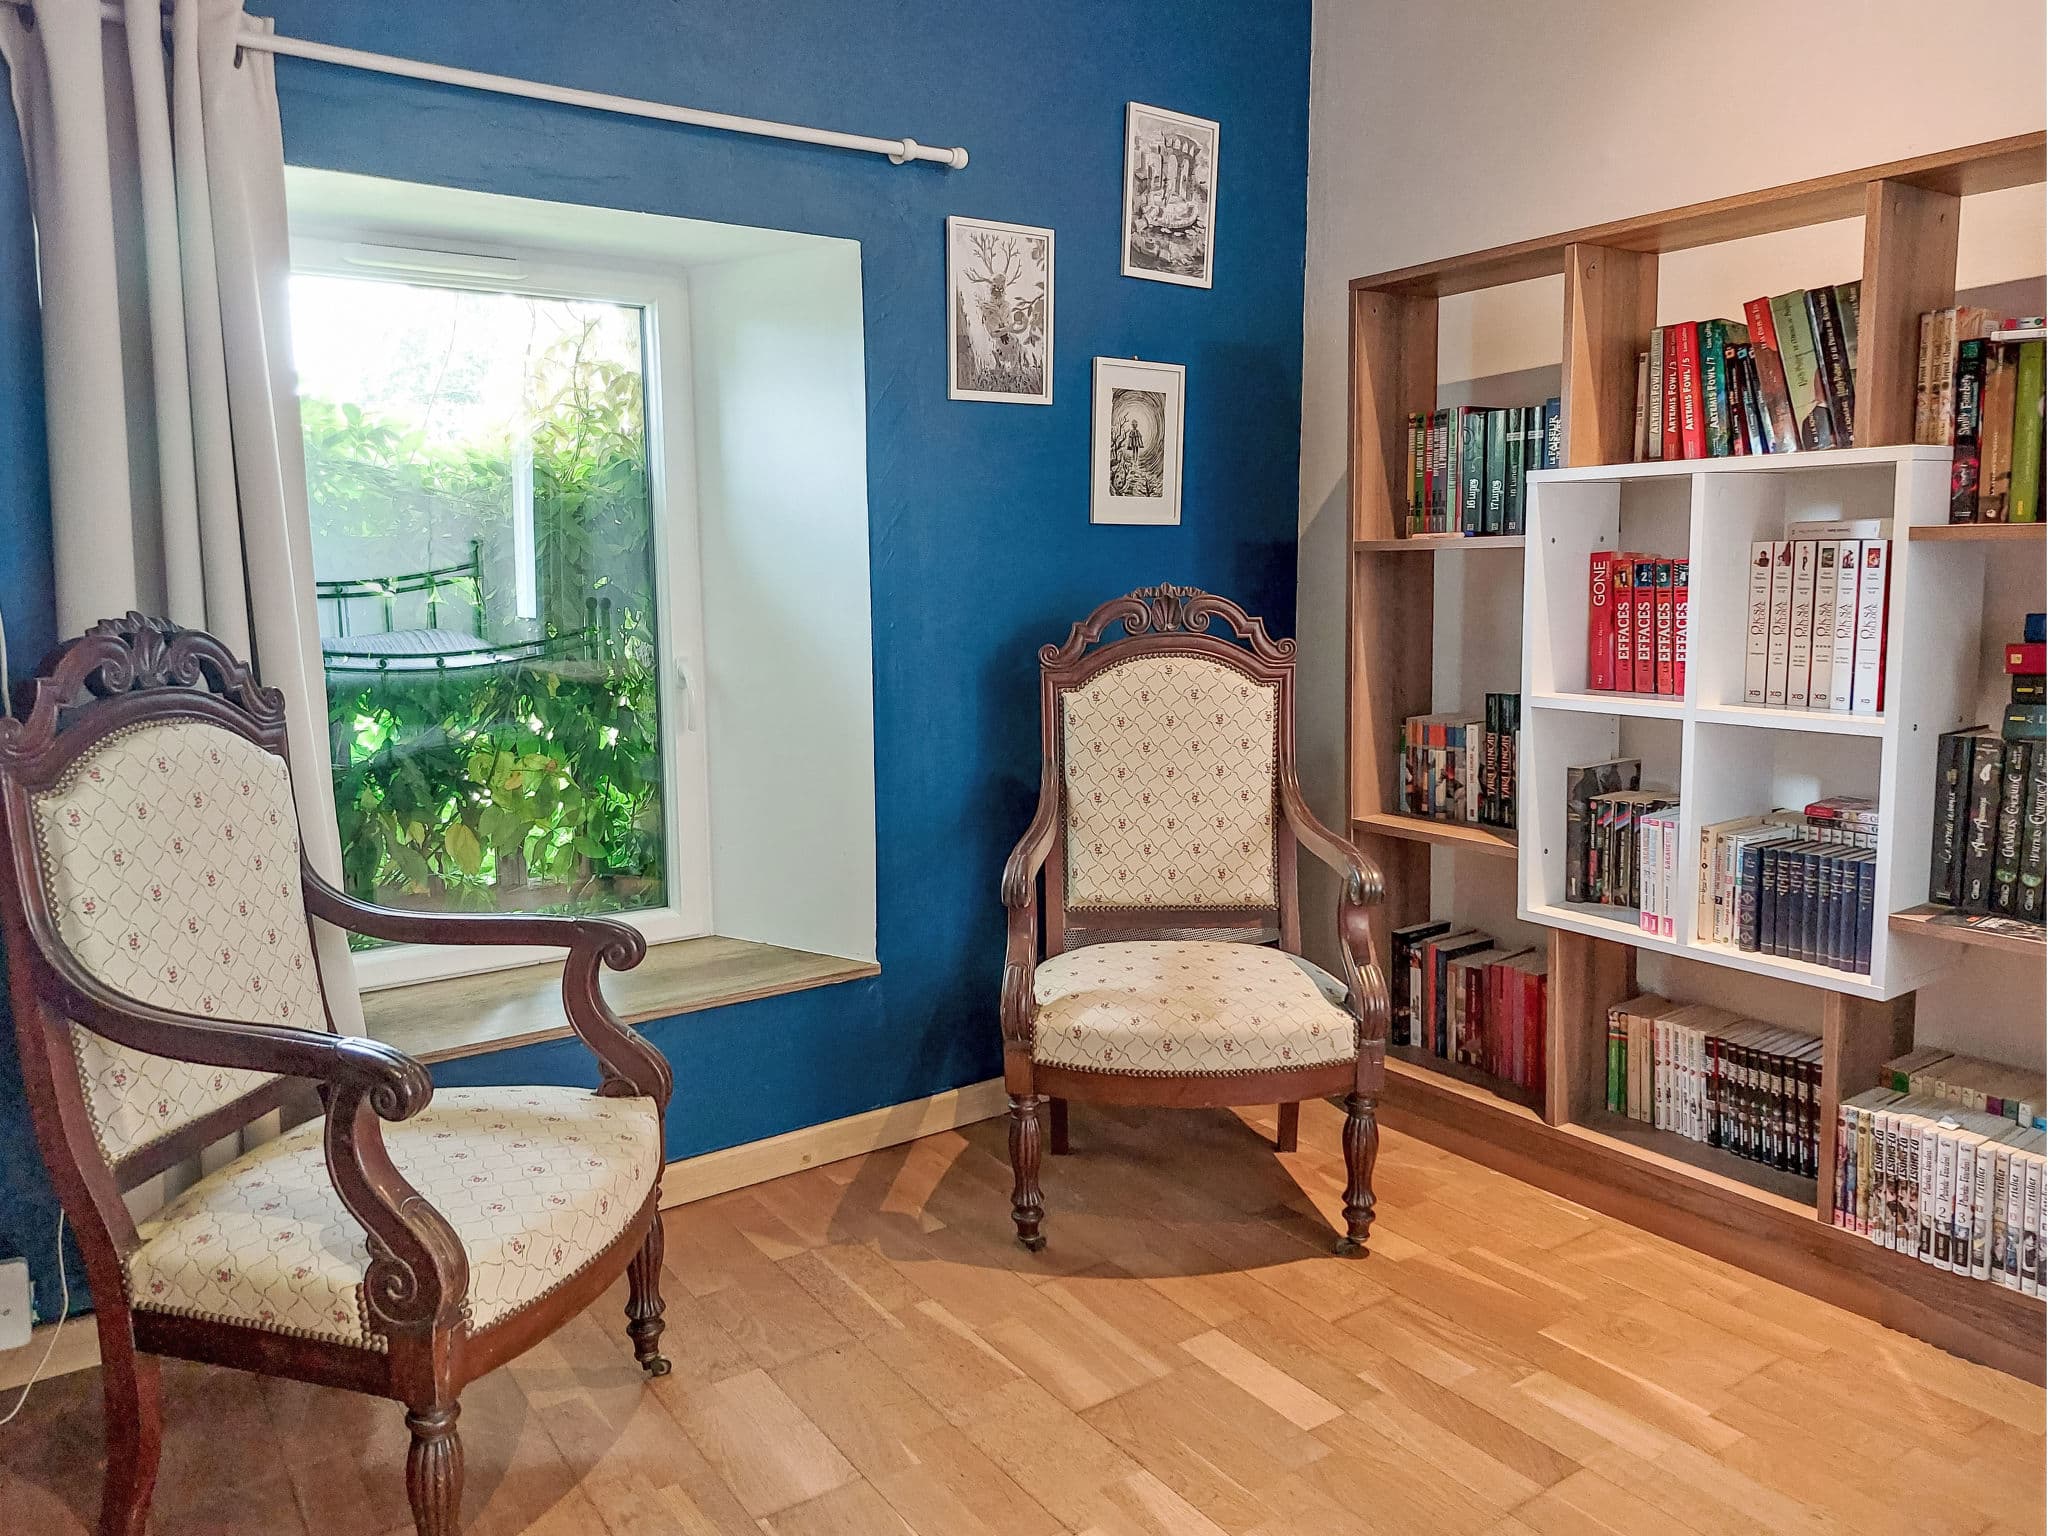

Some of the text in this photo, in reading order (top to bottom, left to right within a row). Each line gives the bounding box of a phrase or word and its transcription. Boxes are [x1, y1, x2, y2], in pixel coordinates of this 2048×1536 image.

[1650, 372, 1659, 395] FOWL
[1668, 372, 1677, 395] FOWL
[1682, 369, 1691, 392] FOWL
[1707, 367, 1716, 390] FOWL
[1651, 397, 1660, 433] ARTEMIS
[1668, 398, 1677, 433] ARTEMIS
[1684, 394, 1694, 430] ARTEMIS
[1709, 393, 1719, 428] ARTEMIS
[1548, 415, 1558, 455] FAISEUR
[1593, 561, 1605, 606] GONE
[1620, 571, 1627, 582] 1
[1640, 571, 1648, 581] 2
[1659, 572, 1667, 582] 3
[1939, 1206, 1946, 1218] 2
[1958, 1212, 1966, 1224] 3
